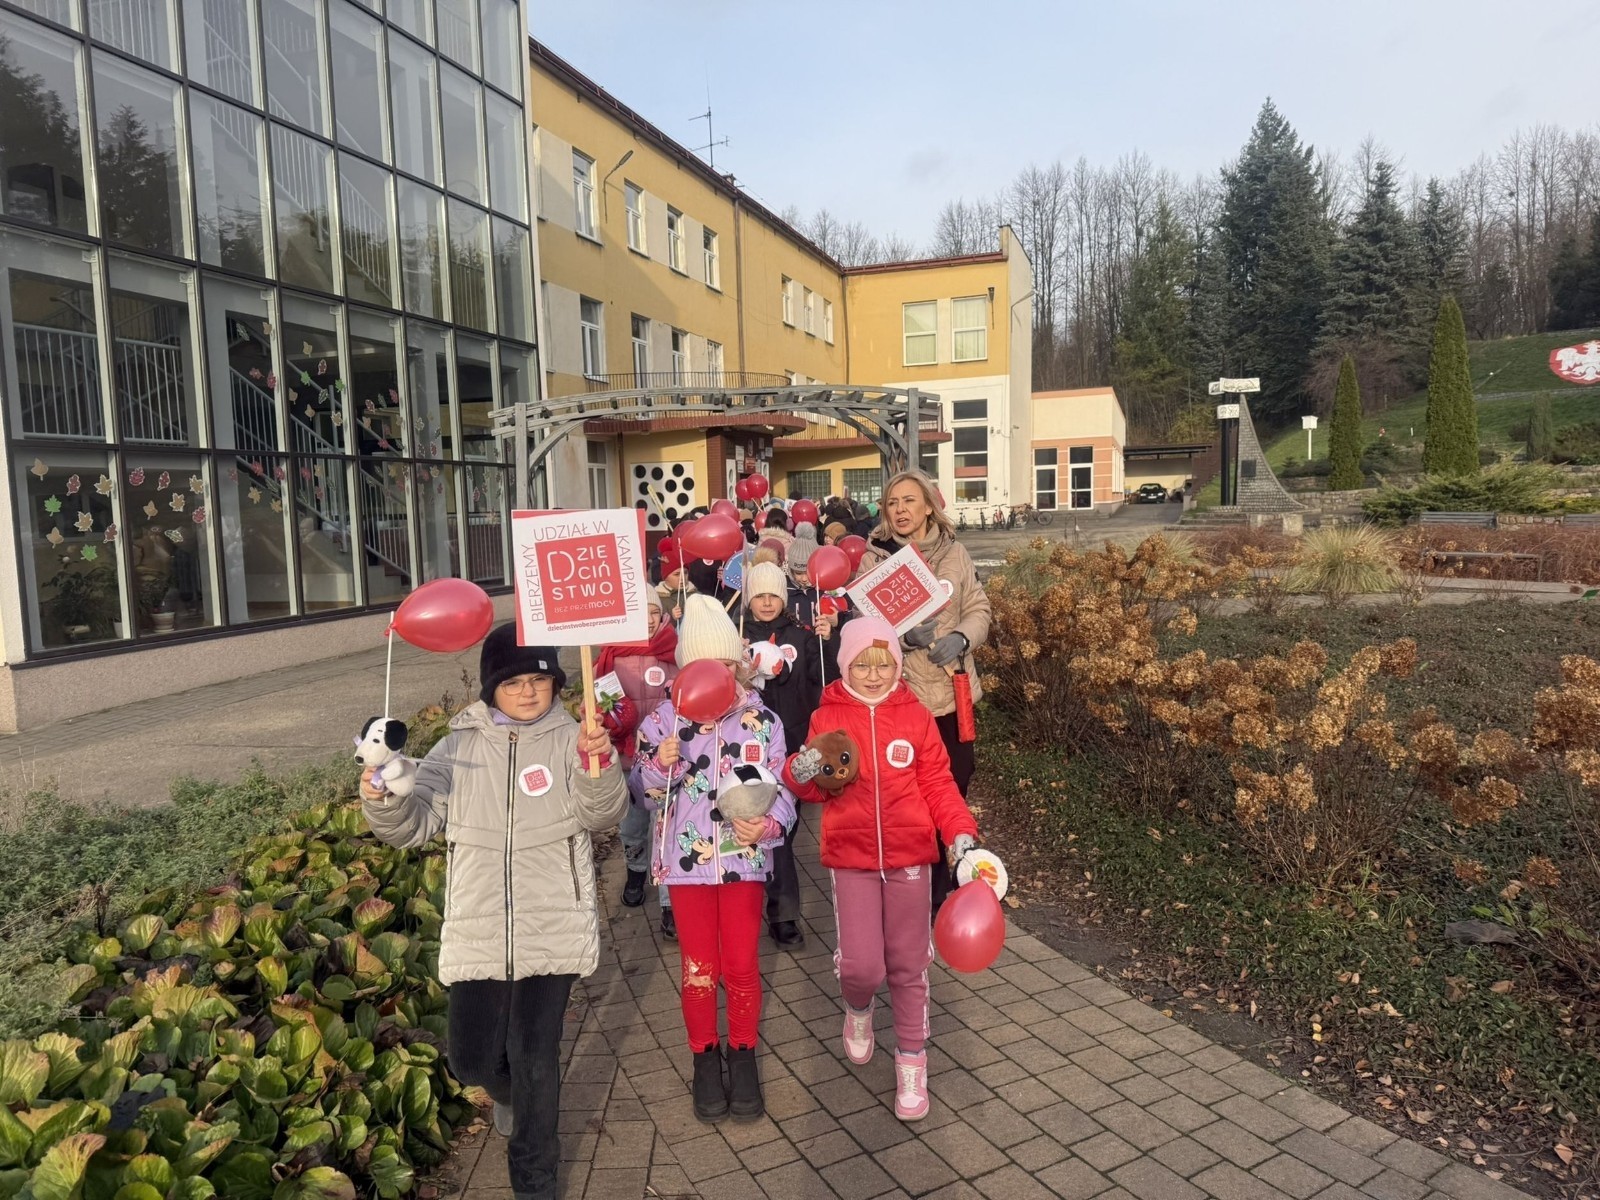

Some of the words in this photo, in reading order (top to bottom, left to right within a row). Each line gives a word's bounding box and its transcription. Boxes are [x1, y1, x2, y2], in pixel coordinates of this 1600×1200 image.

[533, 523, 591, 542] UDZIAŁ
[593, 520, 610, 534] W
[616, 535, 639, 612] KAMPANII
[892, 560, 901, 570] W
[906, 560, 937, 595] KAMPANII
[521, 544, 544, 622] BIERZEMY
[552, 582, 613, 600] STWO
[886, 587, 919, 614] STWO
